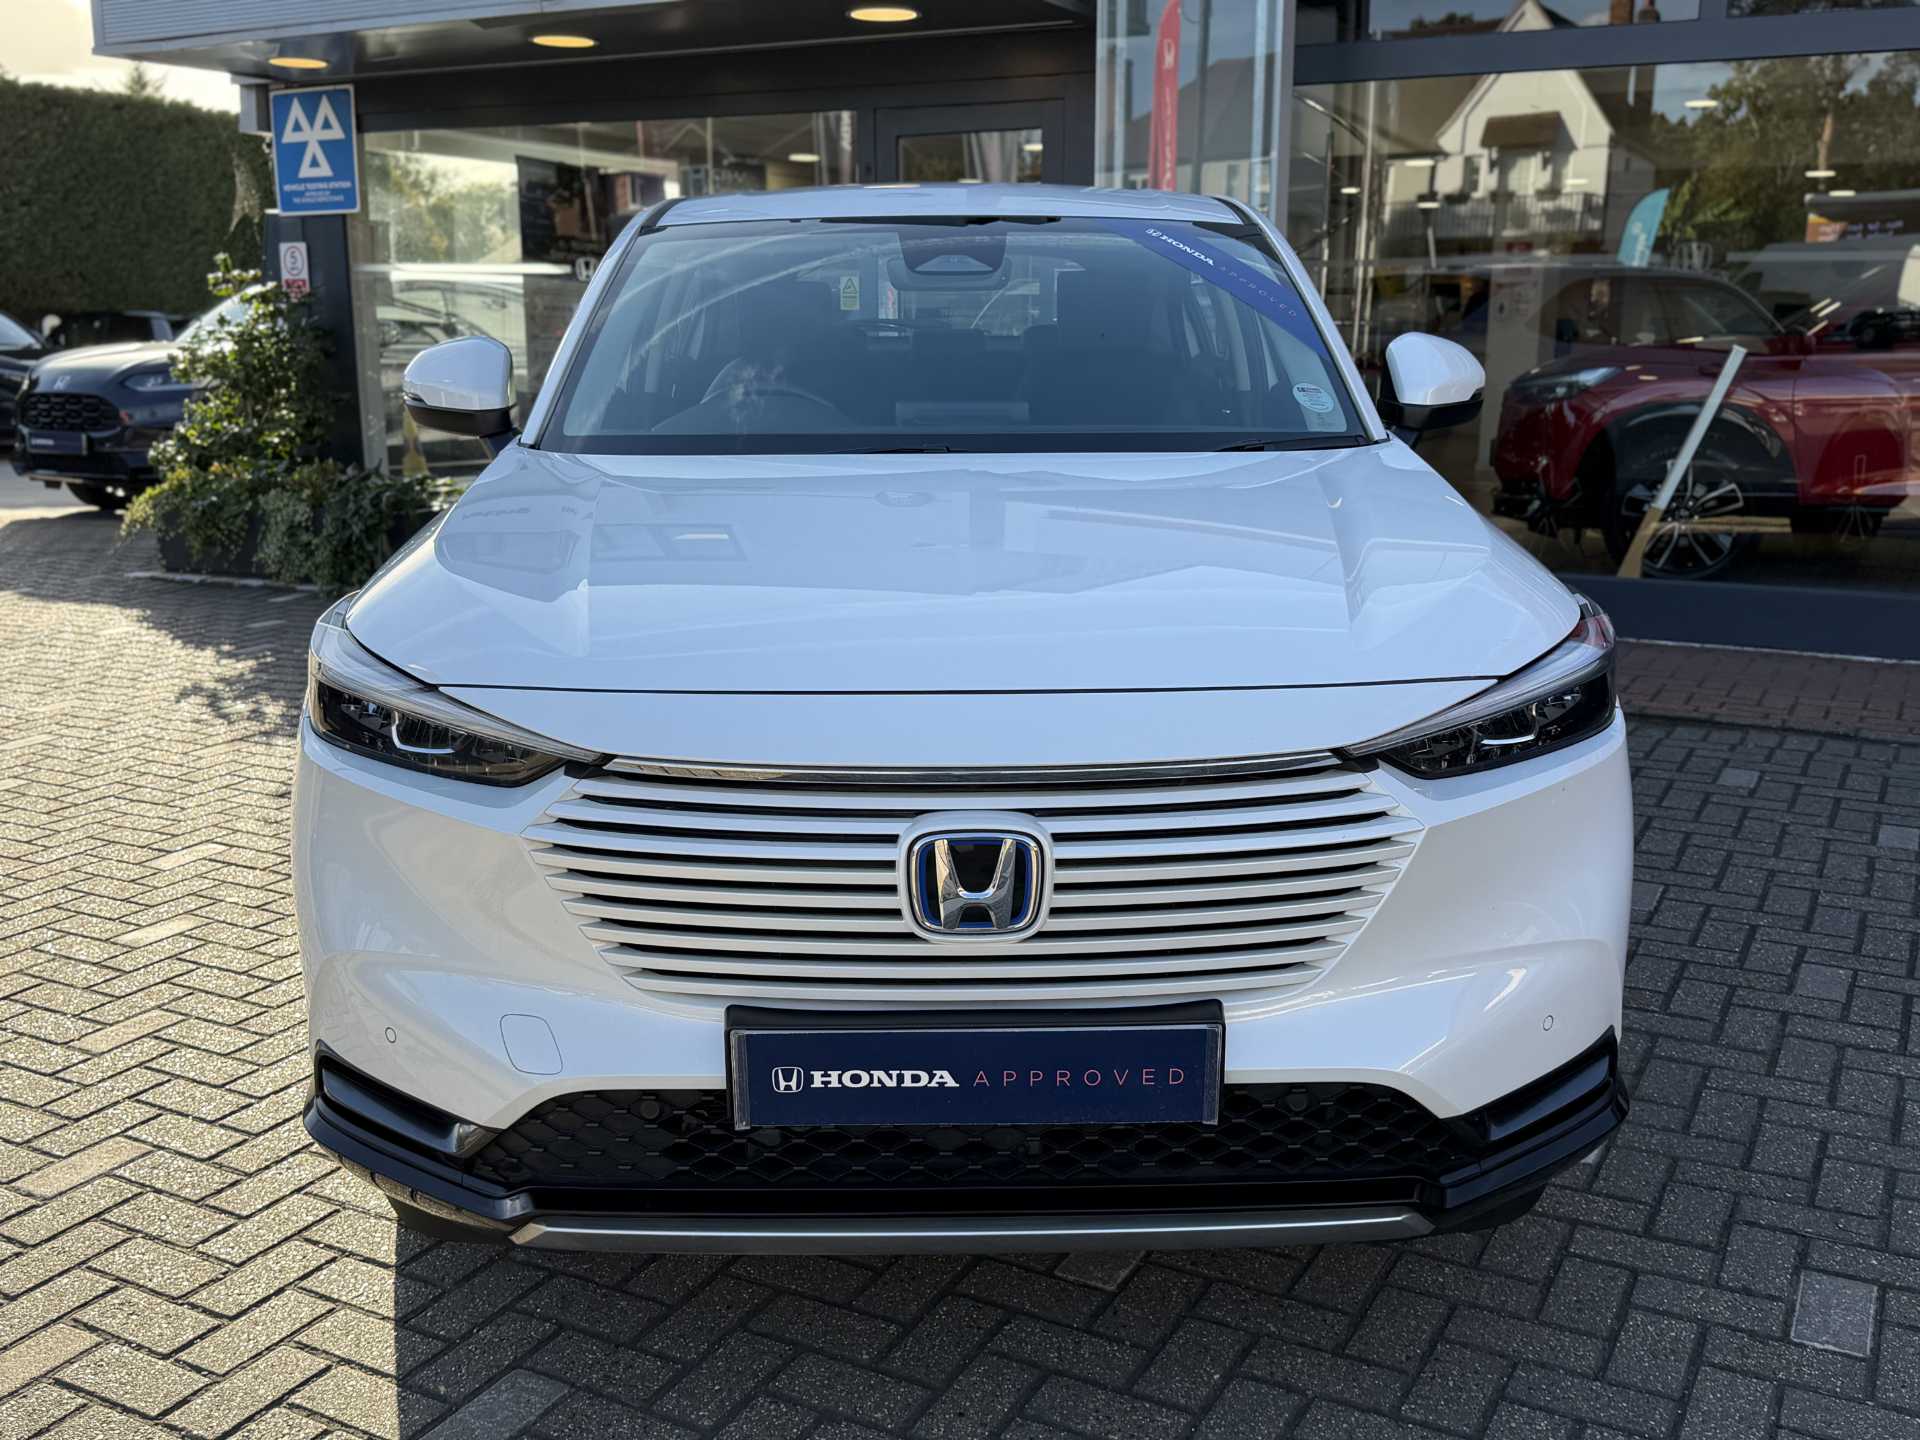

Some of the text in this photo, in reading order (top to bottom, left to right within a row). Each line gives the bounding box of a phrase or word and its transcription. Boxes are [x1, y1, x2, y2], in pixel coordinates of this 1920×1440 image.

[1159, 235, 1214, 266] HONDA
[810, 1069, 960, 1088] HONDA
[973, 1067, 1185, 1087] APPROVED
